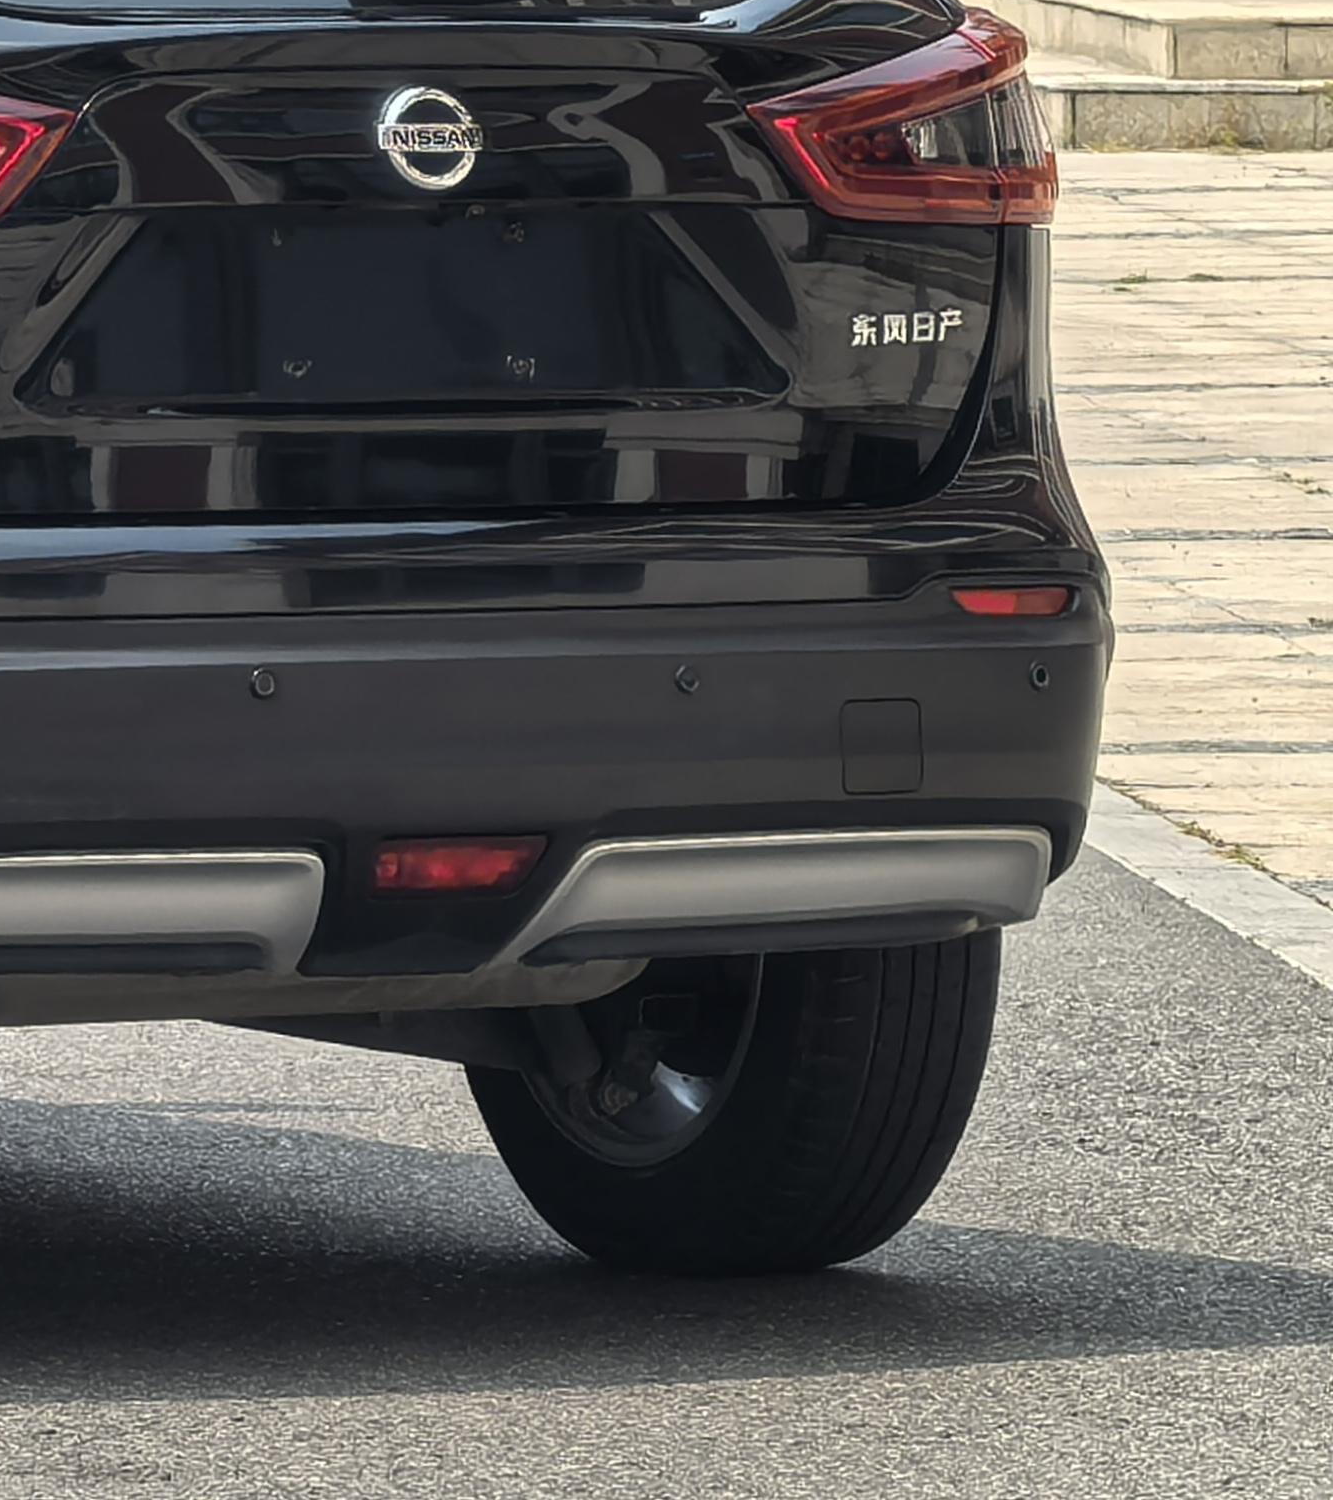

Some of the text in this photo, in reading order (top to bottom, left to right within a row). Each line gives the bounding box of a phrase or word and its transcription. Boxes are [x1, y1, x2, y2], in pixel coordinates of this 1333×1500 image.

[389, 127, 480, 149] NISSAN
[851, 307, 963, 346] 东风日产
